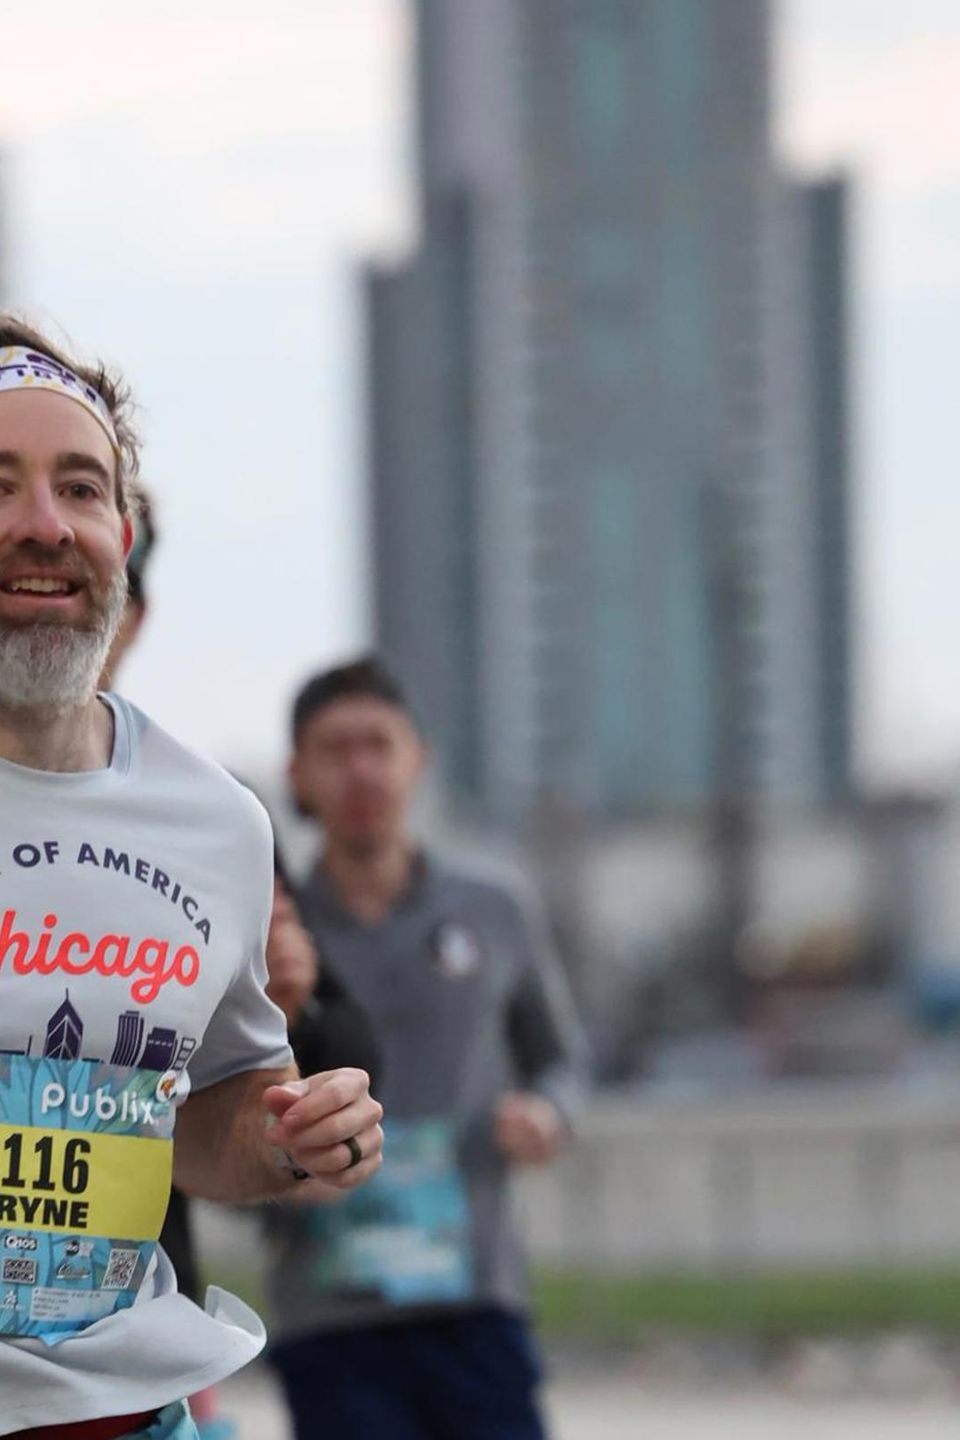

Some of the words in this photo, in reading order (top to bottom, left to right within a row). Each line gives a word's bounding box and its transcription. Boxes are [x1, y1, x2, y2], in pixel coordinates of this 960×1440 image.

[12, 841, 60, 868] OF
[77, 843, 213, 945] AMERICA
[41, 1082, 155, 1125] Publix
[1, 1132, 91, 1194] 116
